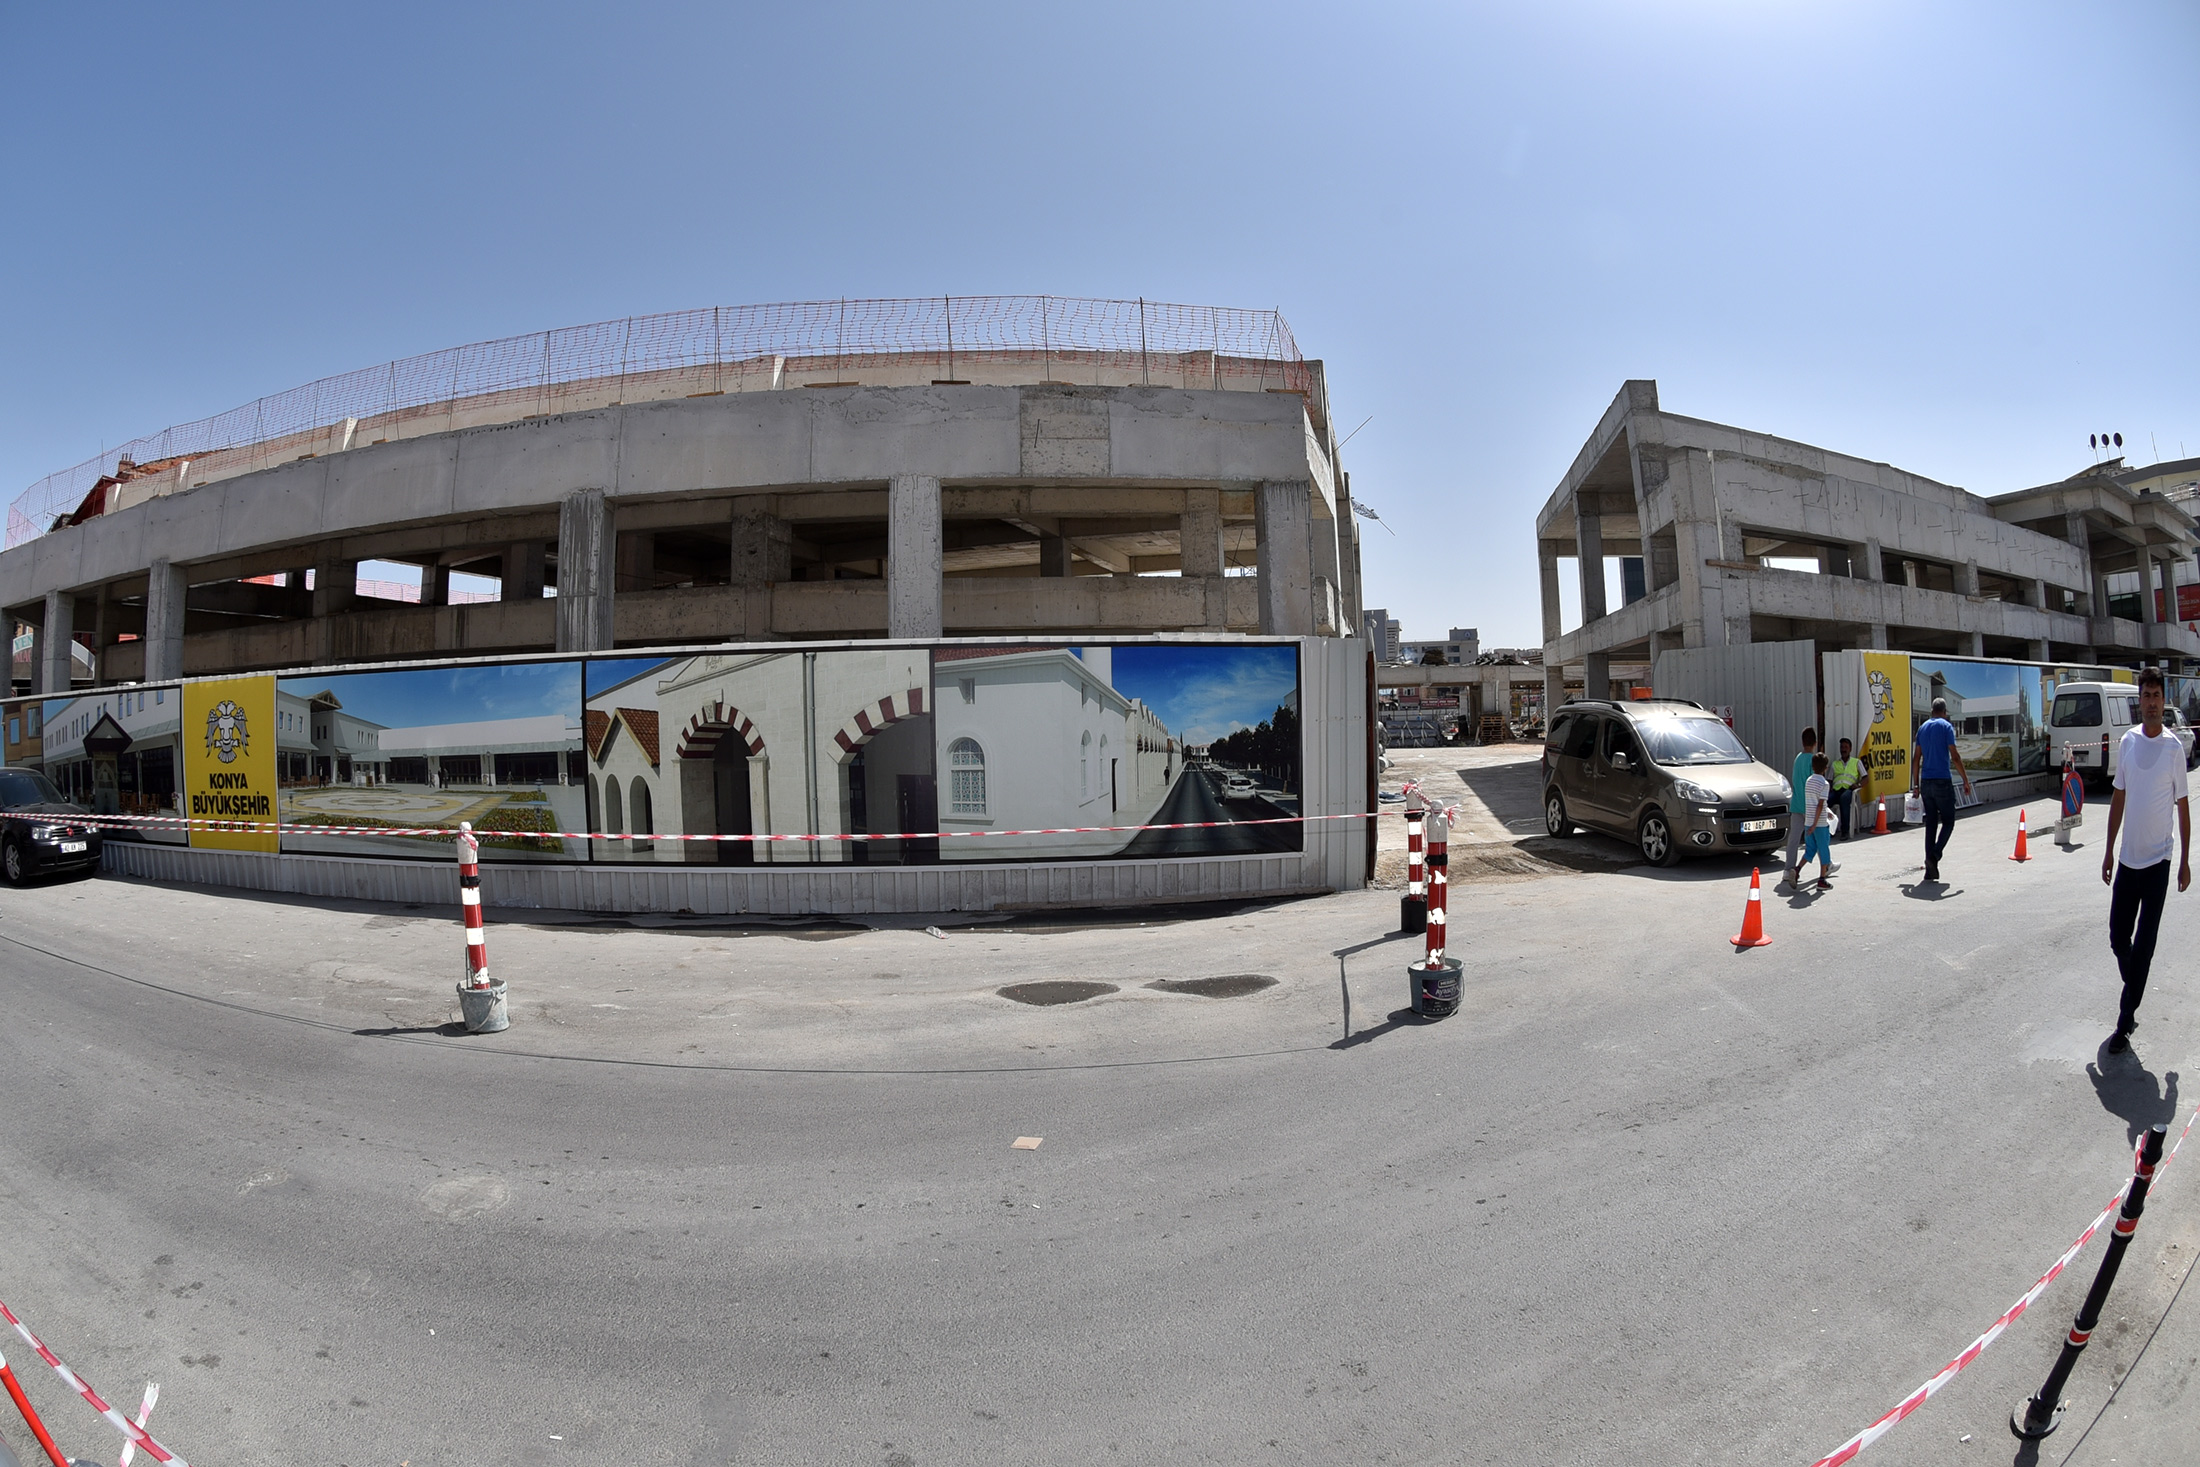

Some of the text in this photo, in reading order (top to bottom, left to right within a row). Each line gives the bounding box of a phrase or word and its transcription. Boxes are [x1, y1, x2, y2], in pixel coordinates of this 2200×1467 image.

[209, 773, 248, 789] KONYA
[192, 791, 270, 818] BÜYÜKŞEHİR
[1743, 822, 1751, 831] 42
